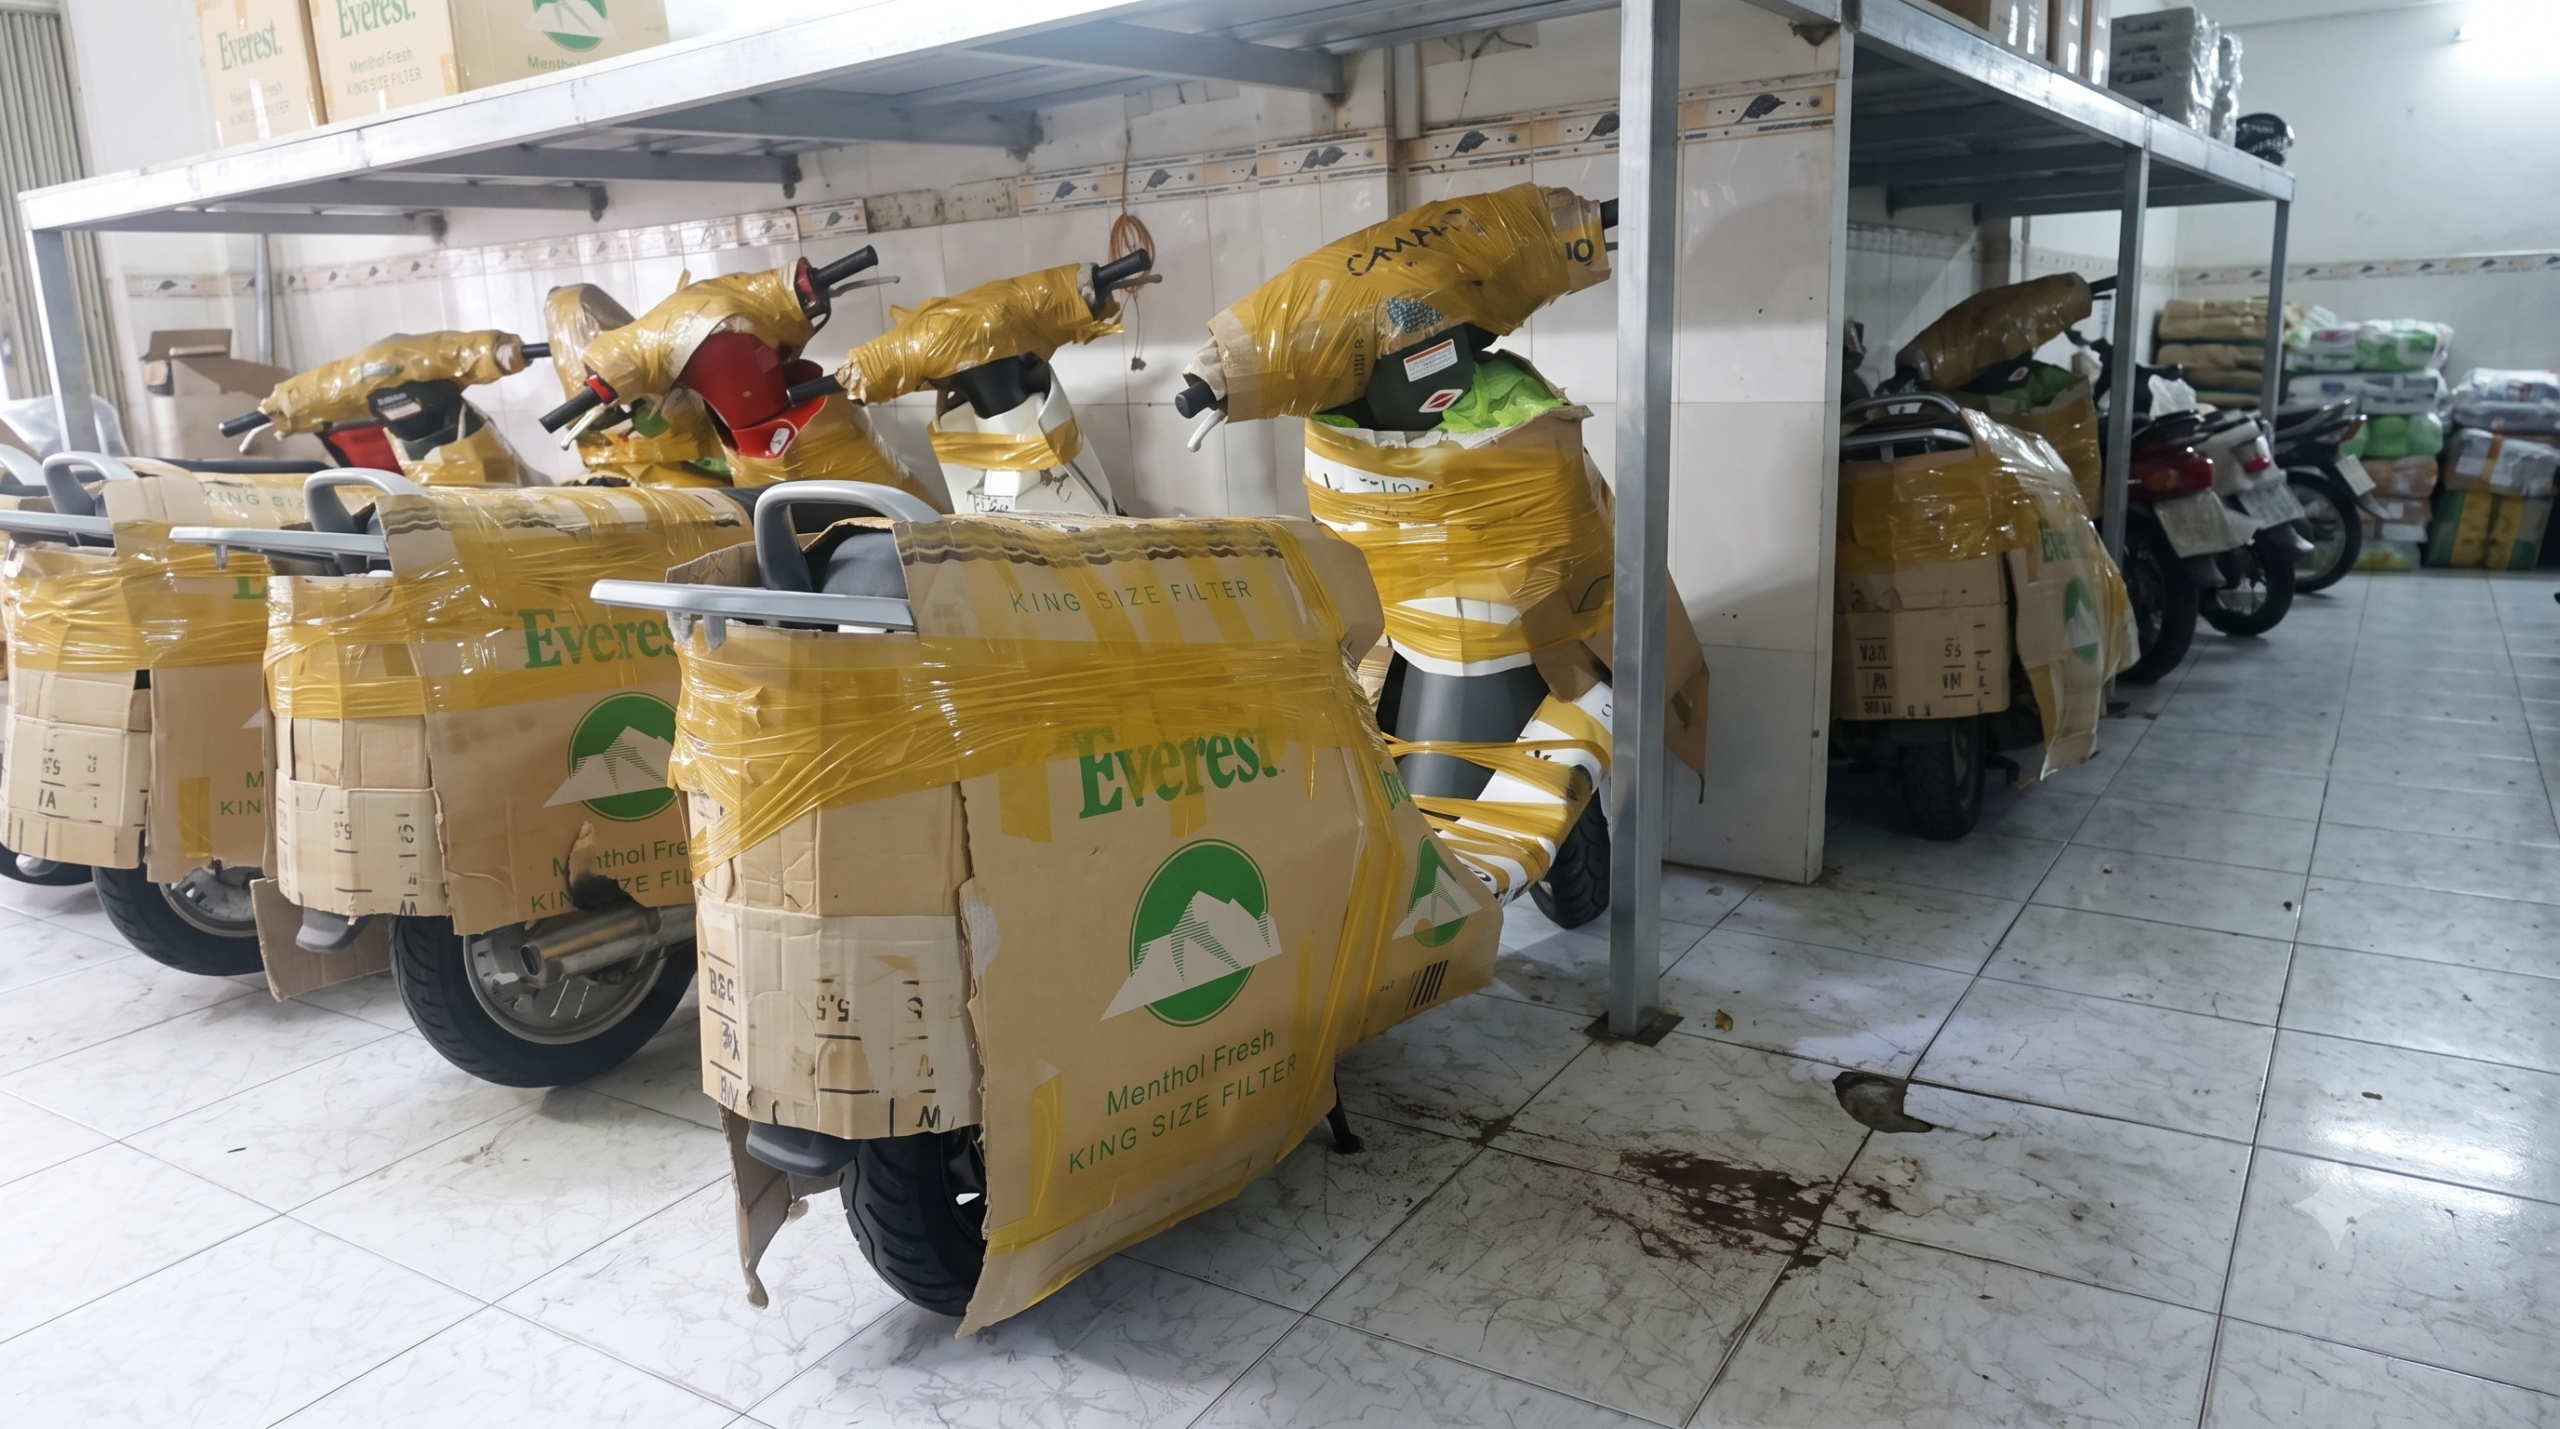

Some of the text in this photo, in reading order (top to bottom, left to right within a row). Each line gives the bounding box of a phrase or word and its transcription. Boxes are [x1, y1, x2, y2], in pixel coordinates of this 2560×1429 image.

[349, 47, 414, 75] Menthol Fresh
[346, 66, 423, 97] KING SIZE FILTER
[272, 495, 305, 510] SIZ
[1010, 580, 1252, 613] KING SIZE FILTER
[221, 799, 261, 816] KIN
[653, 839, 687, 860] Fre
[531, 889, 572, 914] KIN
[660, 868, 692, 889] FIL
[1107, 1028, 1274, 1117] Menthol Fresh
[1069, 1052, 1297, 1175] KING SIZE FILTER
